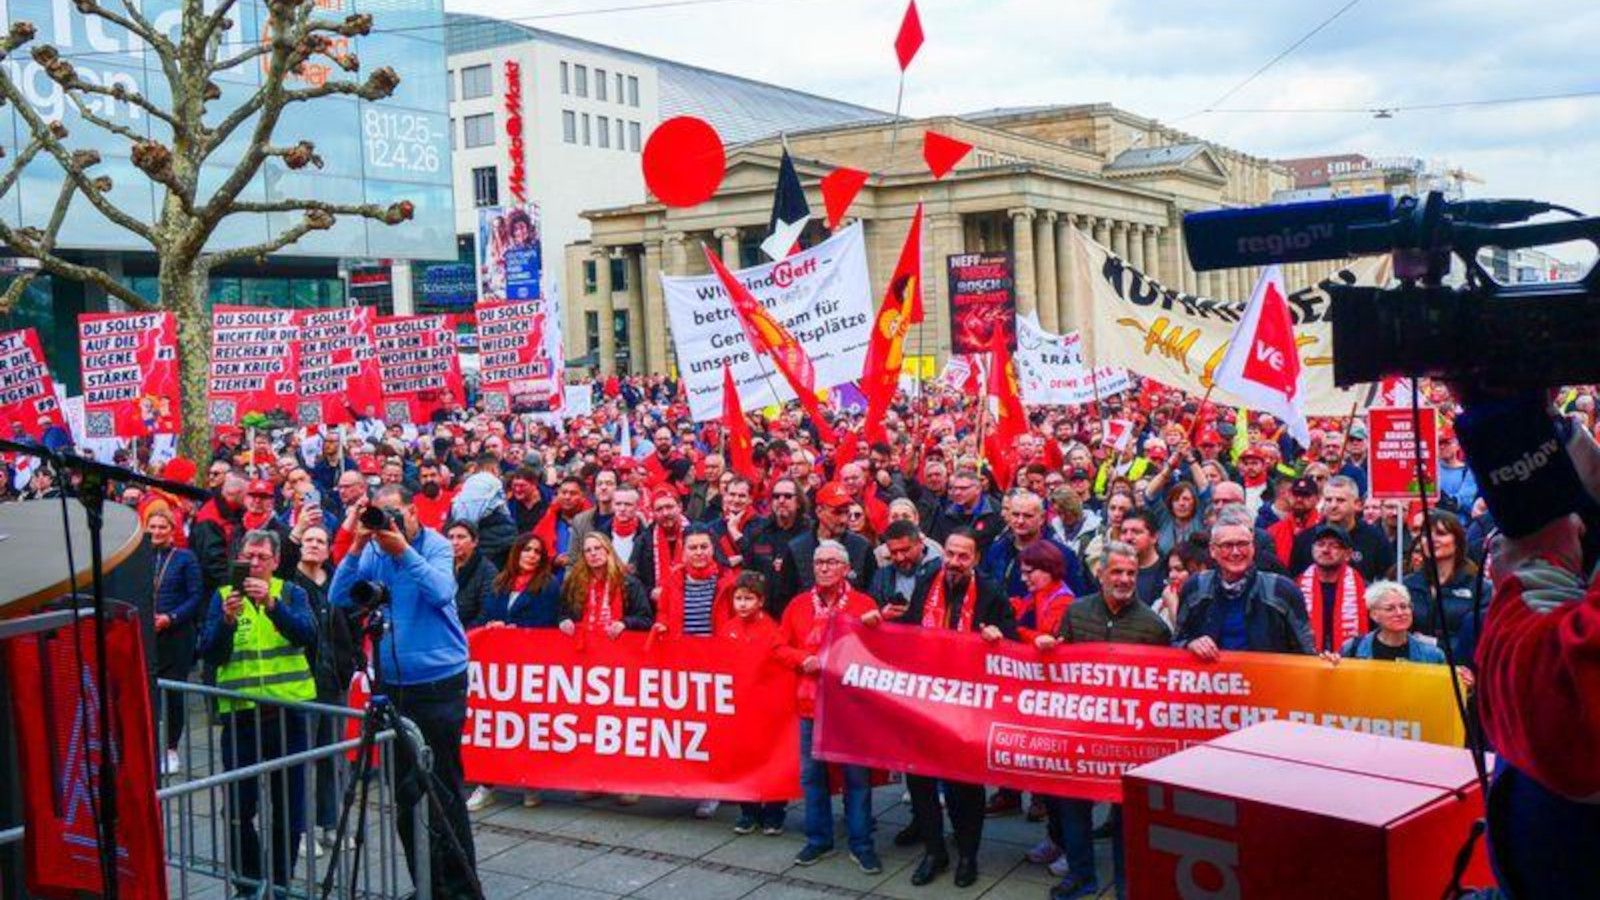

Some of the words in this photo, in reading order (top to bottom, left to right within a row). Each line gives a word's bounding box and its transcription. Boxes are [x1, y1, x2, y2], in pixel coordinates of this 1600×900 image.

[369, 141, 440, 172] 12.4.26
[951, 255, 981, 269] NEFF
[780, 259, 817, 282] Neff
[957, 280, 1005, 292] BOSCH
[480, 311, 496, 321] DU
[498, 302, 540, 318] SOLLST
[815, 299, 841, 319] für
[83, 324, 102, 335] DU
[106, 316, 156, 332] SOLLST
[217, 314, 235, 325] DU
[238, 312, 285, 325] SOLLST
[311, 311, 351, 324] SOLLST
[376, 325, 391, 337] DU
[395, 319, 437, 331] SOLLST
[482, 319, 529, 335] ENDLICH
[217, 331, 252, 342] NICHT
[255, 329, 277, 341] FÜR
[380, 340, 395, 349] AN
[398, 337, 420, 348] DEN
[438, 332, 453, 342] #2
[482, 336, 525, 350] WIEDER
[86, 338, 110, 352] AUF
[115, 336, 135, 348] DIE
[216, 346, 269, 358] REICHEN
[272, 345, 285, 356] IN
[86, 352, 133, 368] EIGENE
[158, 348, 173, 359] #1
[485, 352, 516, 366] MEHR
[215, 364, 240, 374] DEN
[244, 361, 280, 372] KRIEG
[690, 351, 750, 373] unsere
[4, 364, 42, 387] NICHT
[486, 363, 543, 379] STREIKEN!
[213, 378, 263, 390] ZIEHEN!
[278, 382, 293, 392] #6
[88, 386, 137, 402] BAUEN!
[38, 398, 54, 411] #9
[985, 654, 1046, 680] KEINE
[1049, 661, 1251, 696] LIFESTYLE-FRAGE:
[841, 663, 999, 709] ARBEITSZEIT
[1018, 689, 1145, 730] GEREGELT,
[996, 731, 1027, 749] GUTE
[1030, 736, 1069, 753] ARBEIT
[995, 750, 1011, 766] IG
[1013, 752, 1073, 772] METALL
